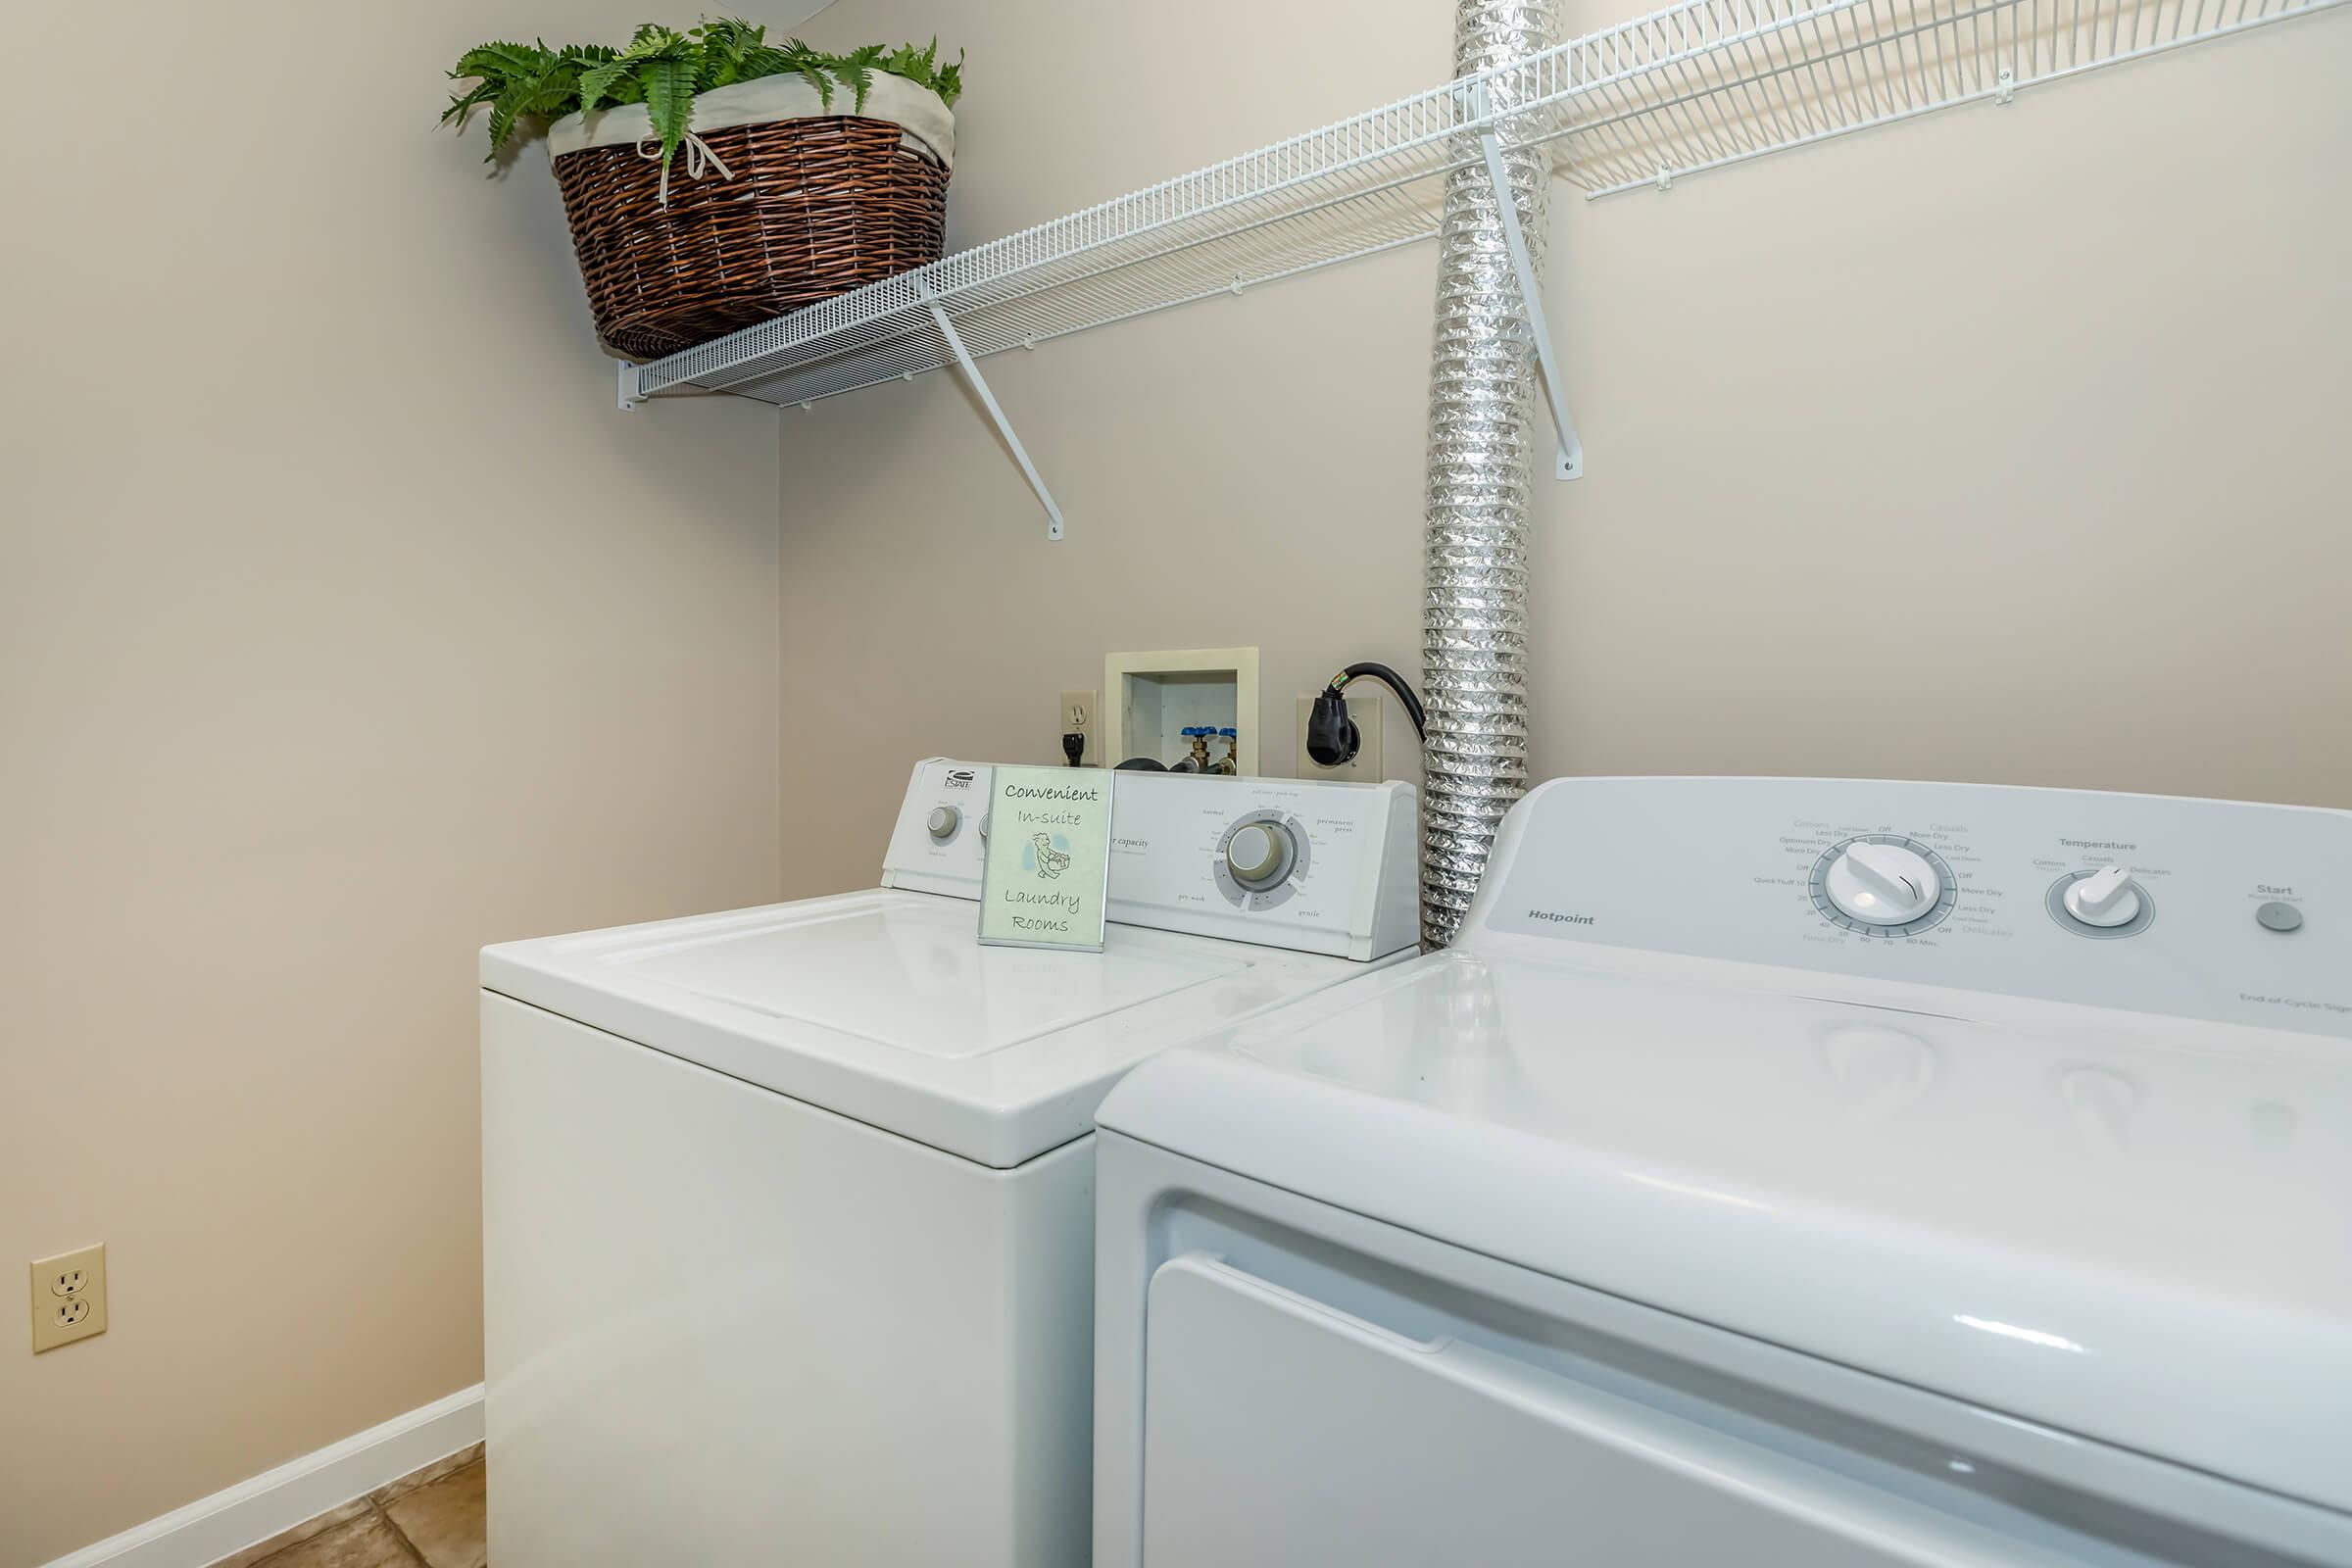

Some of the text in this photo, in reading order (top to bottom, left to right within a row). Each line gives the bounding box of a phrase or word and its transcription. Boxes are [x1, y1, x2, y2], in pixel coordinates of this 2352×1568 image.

[1004, 784, 1099, 802] Convenient
[1017, 809, 1082, 826] In-suite
[1316, 818, 1354, 827] permanent
[1834, 830, 1849, 839] Dry
[1933, 832, 1949, 842] Dry
[1117, 837, 1149, 849] capacity
[1779, 836, 1817, 846] Optimum
[2059, 838, 2137, 852] Temperature
[1806, 847, 1822, 857] Dry
[1934, 843, 1971, 854] Less Dry
[2033, 858, 2067, 868] Cottons
[2082, 854, 2115, 863] Casuals
[1958, 871, 1974, 880] Off
[2131, 865, 2172, 877] Delicates
[1753, 876, 1778, 885] Quick
[1961, 886, 2004, 899] More Dry
[2257, 884, 2293, 895] Start
[1004, 889, 1081, 915] Laundry
[1178, 893, 1205, 903] pre-wash
[1298, 909, 1321, 918] gentle
[1958, 905, 1996, 915] Less Dry
[1529, 909, 1594, 925] Hotpoint
[1011, 915, 1069, 933] Rooms
[2238, 992, 2266, 1004] End
[2284, 998, 2322, 1009] Cycle
